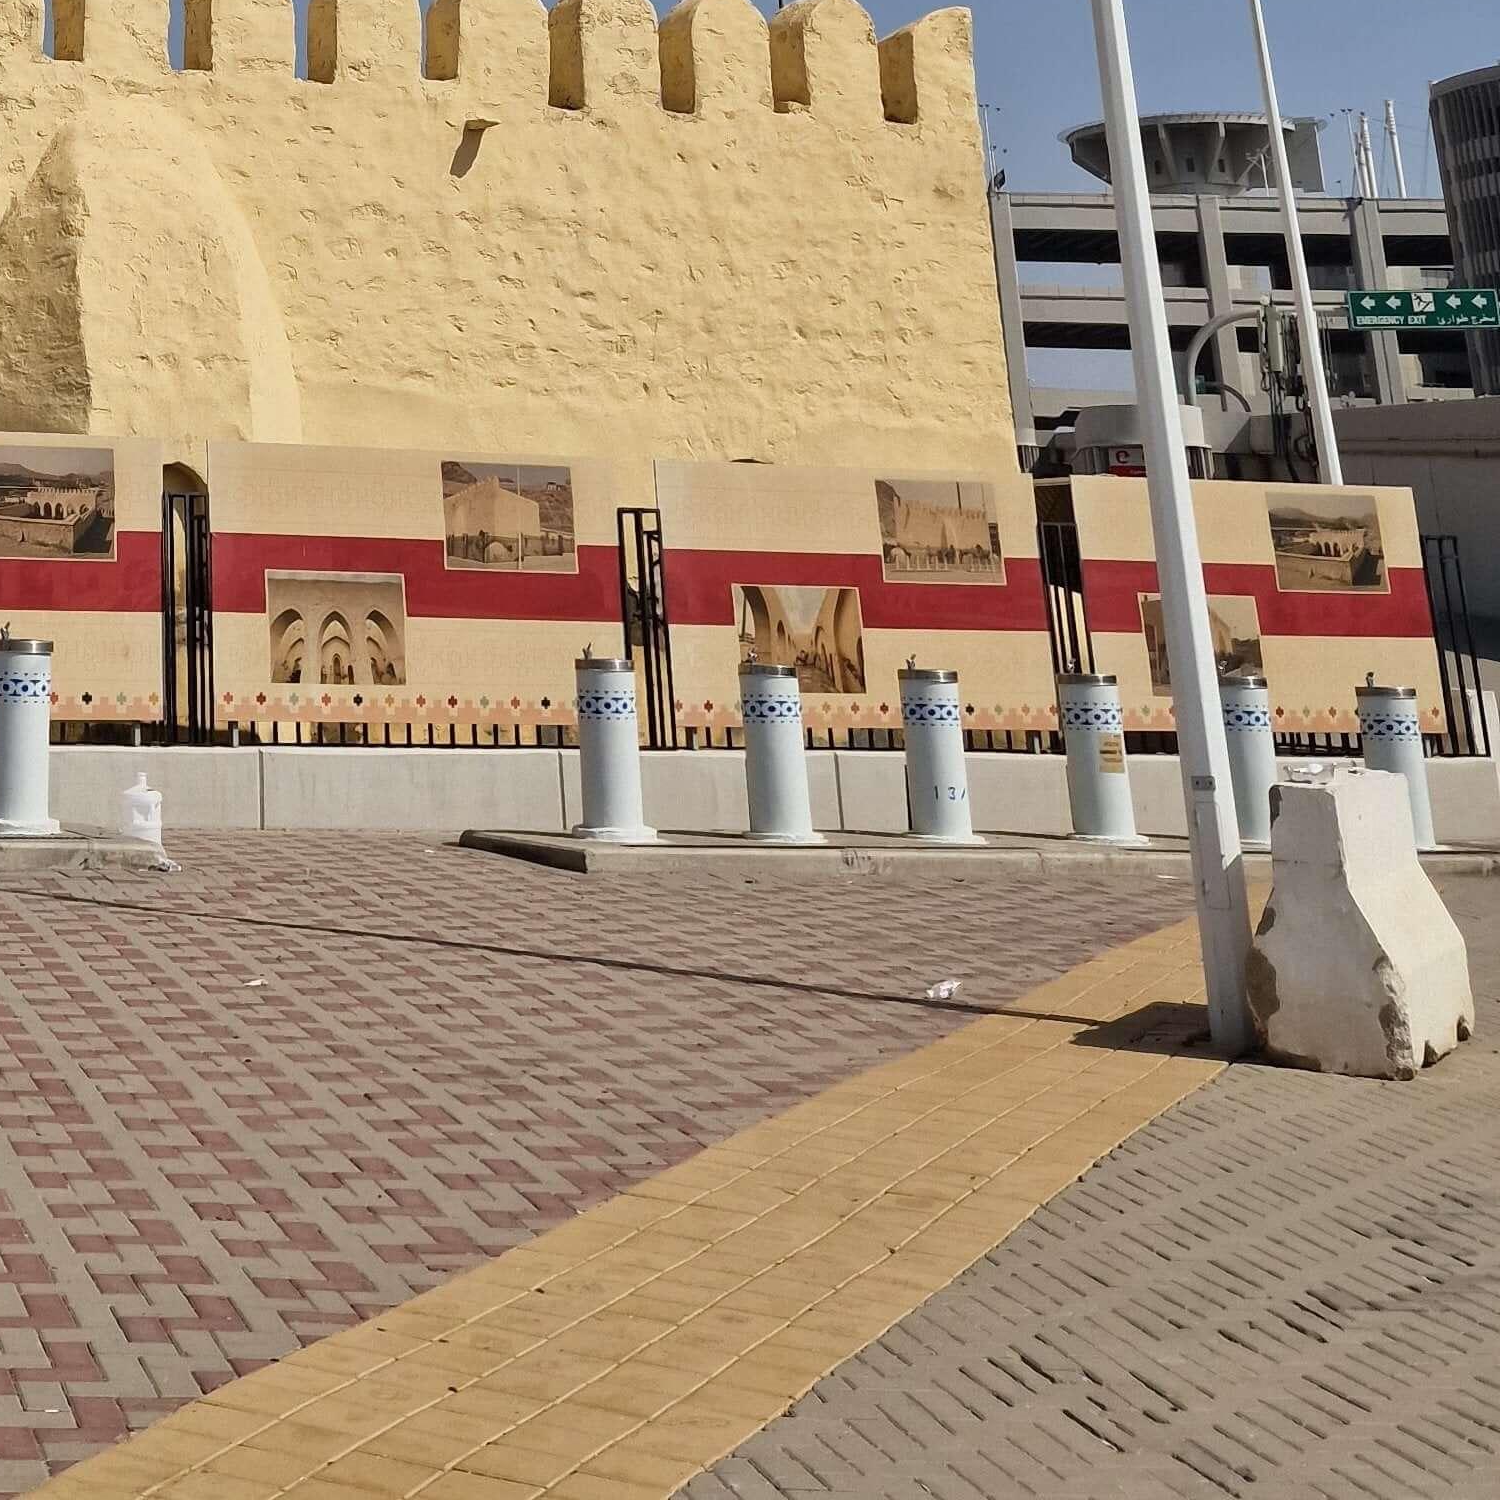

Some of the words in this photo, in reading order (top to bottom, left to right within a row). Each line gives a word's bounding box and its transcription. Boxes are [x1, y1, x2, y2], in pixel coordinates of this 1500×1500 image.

[1356, 315, 1404, 325] EMERGENCY
[1407, 315, 1427, 325] EXIT
[1471, 314, 1496, 325] مخرج
